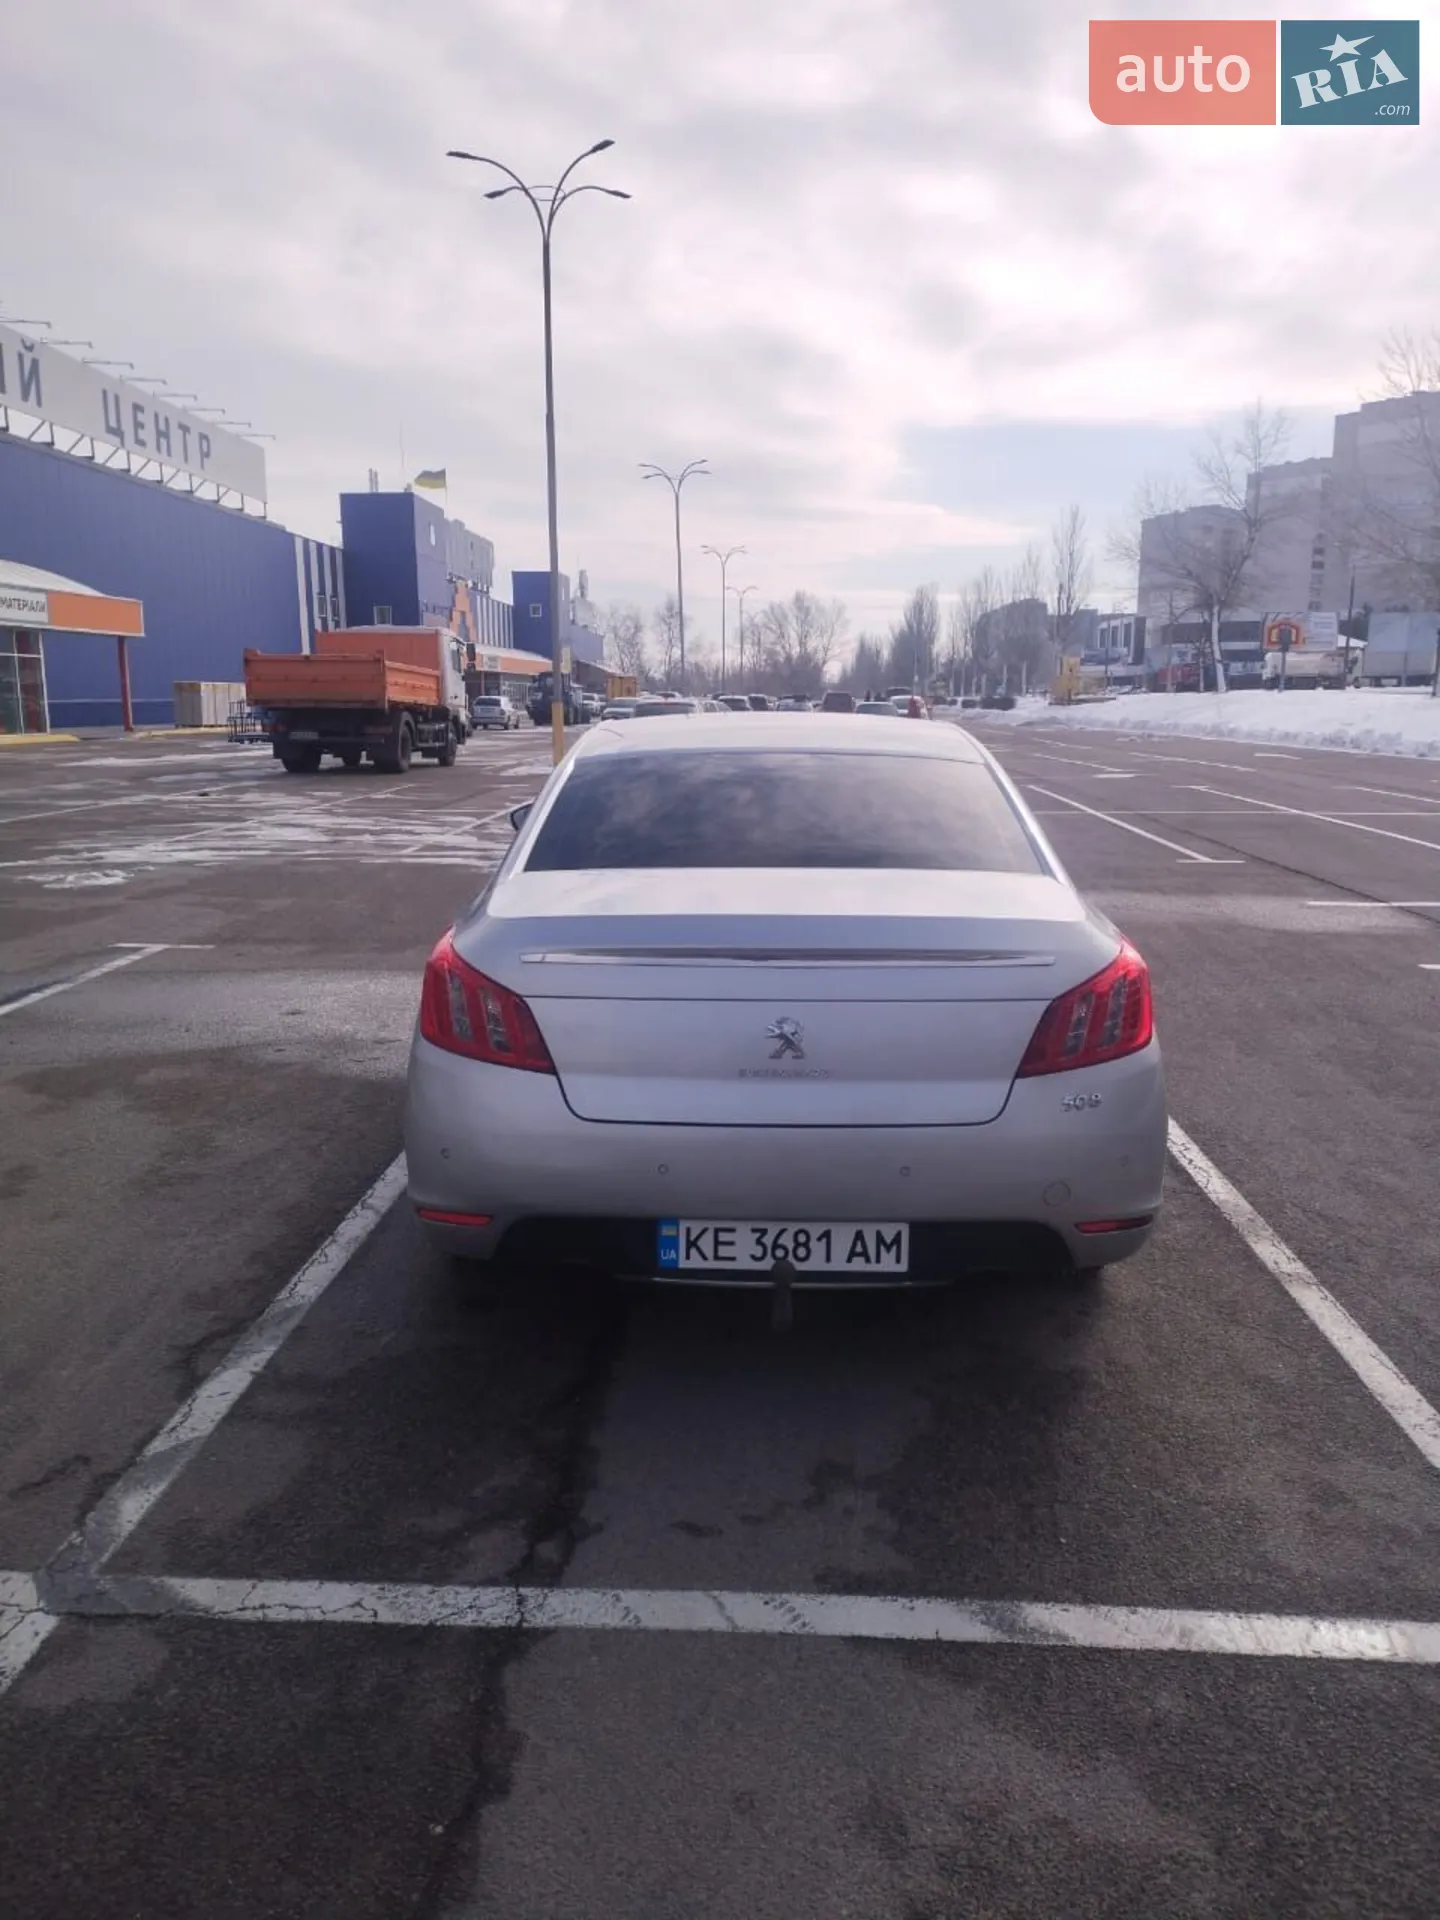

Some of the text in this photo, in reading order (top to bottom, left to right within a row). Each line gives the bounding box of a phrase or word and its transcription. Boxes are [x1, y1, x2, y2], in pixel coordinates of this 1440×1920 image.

[102, 388, 211, 470] ЦЕНТР
[661, 1249, 677, 1260] UA
[685, 1227, 902, 1264] KE 3681 AM
